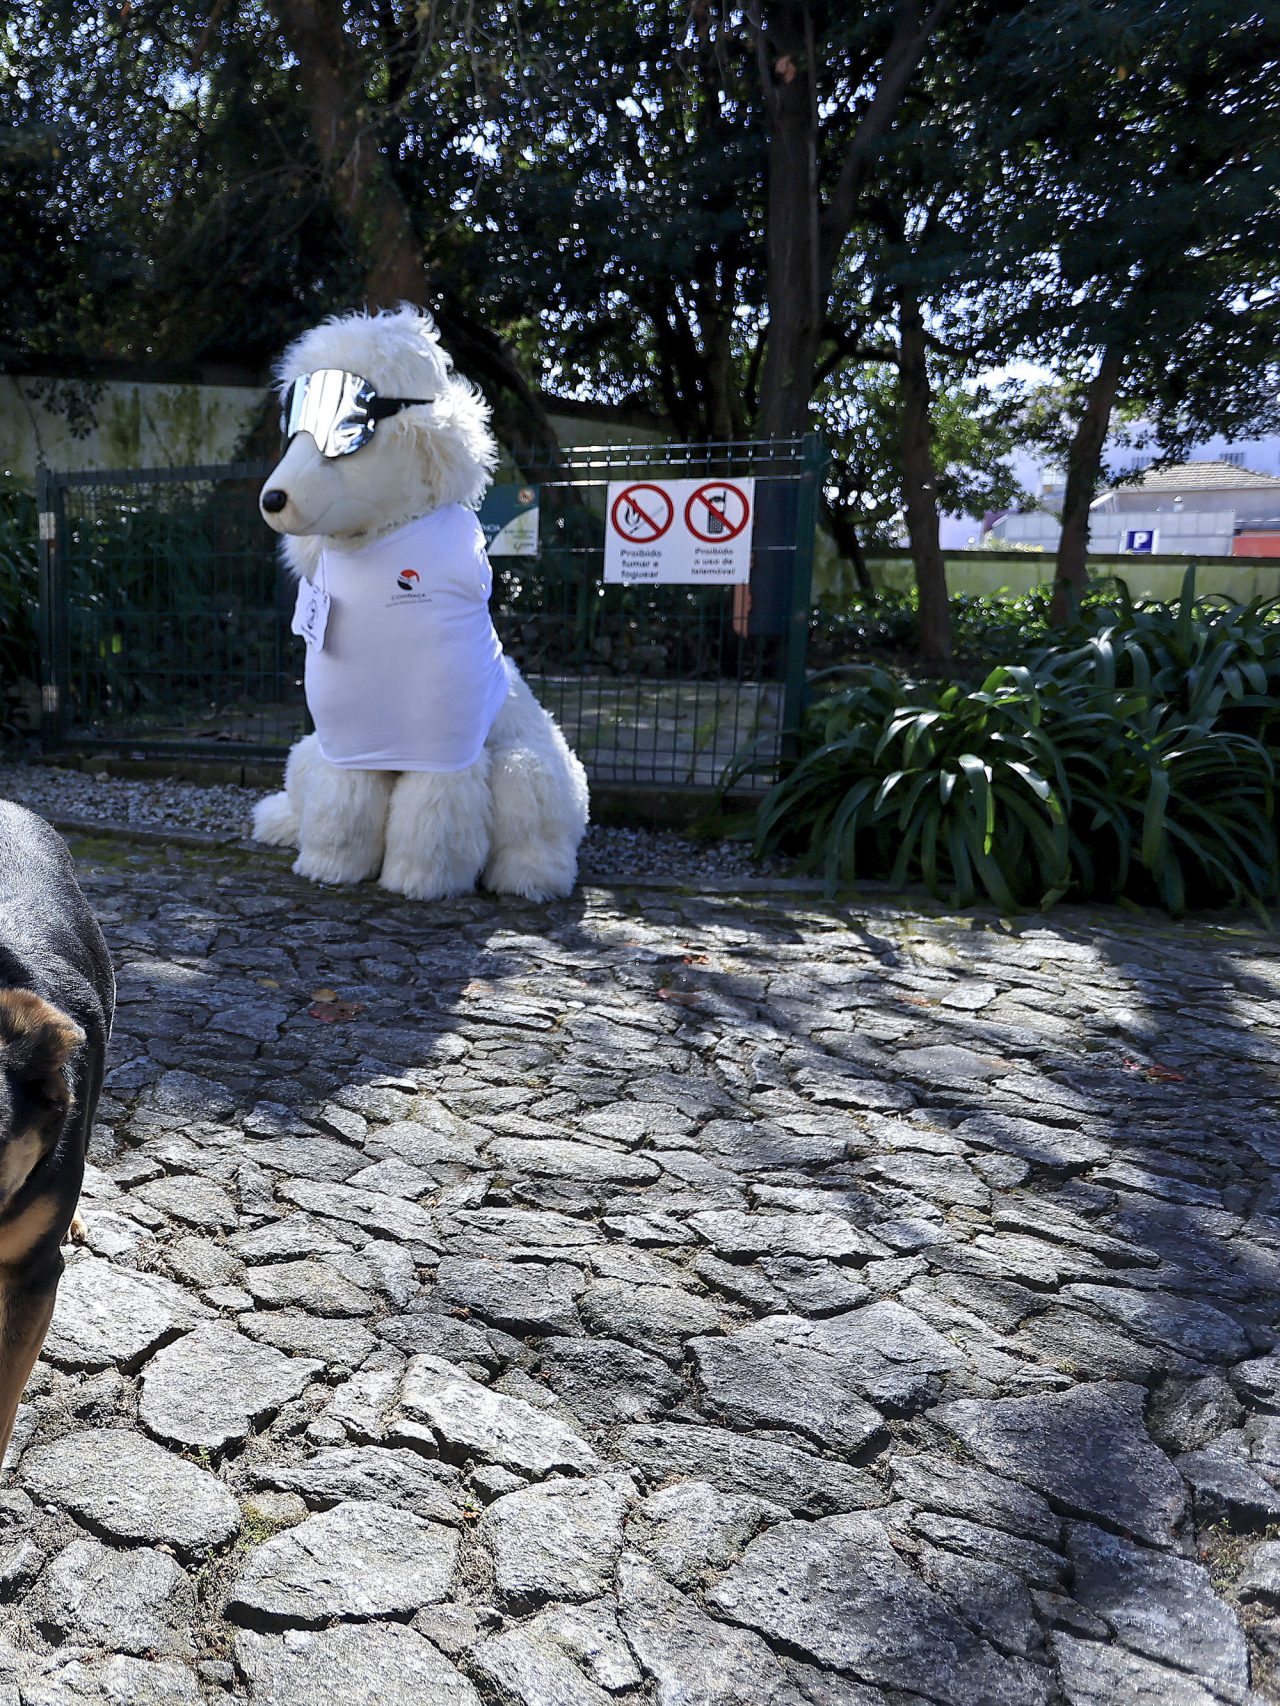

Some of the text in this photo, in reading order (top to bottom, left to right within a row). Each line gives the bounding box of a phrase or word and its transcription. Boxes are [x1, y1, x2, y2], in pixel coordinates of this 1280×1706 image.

[1133, 532, 1149, 549] P
[620, 549, 662, 558] Proibido
[622, 560, 650, 568] fumar
[721, 557, 733, 565] de
